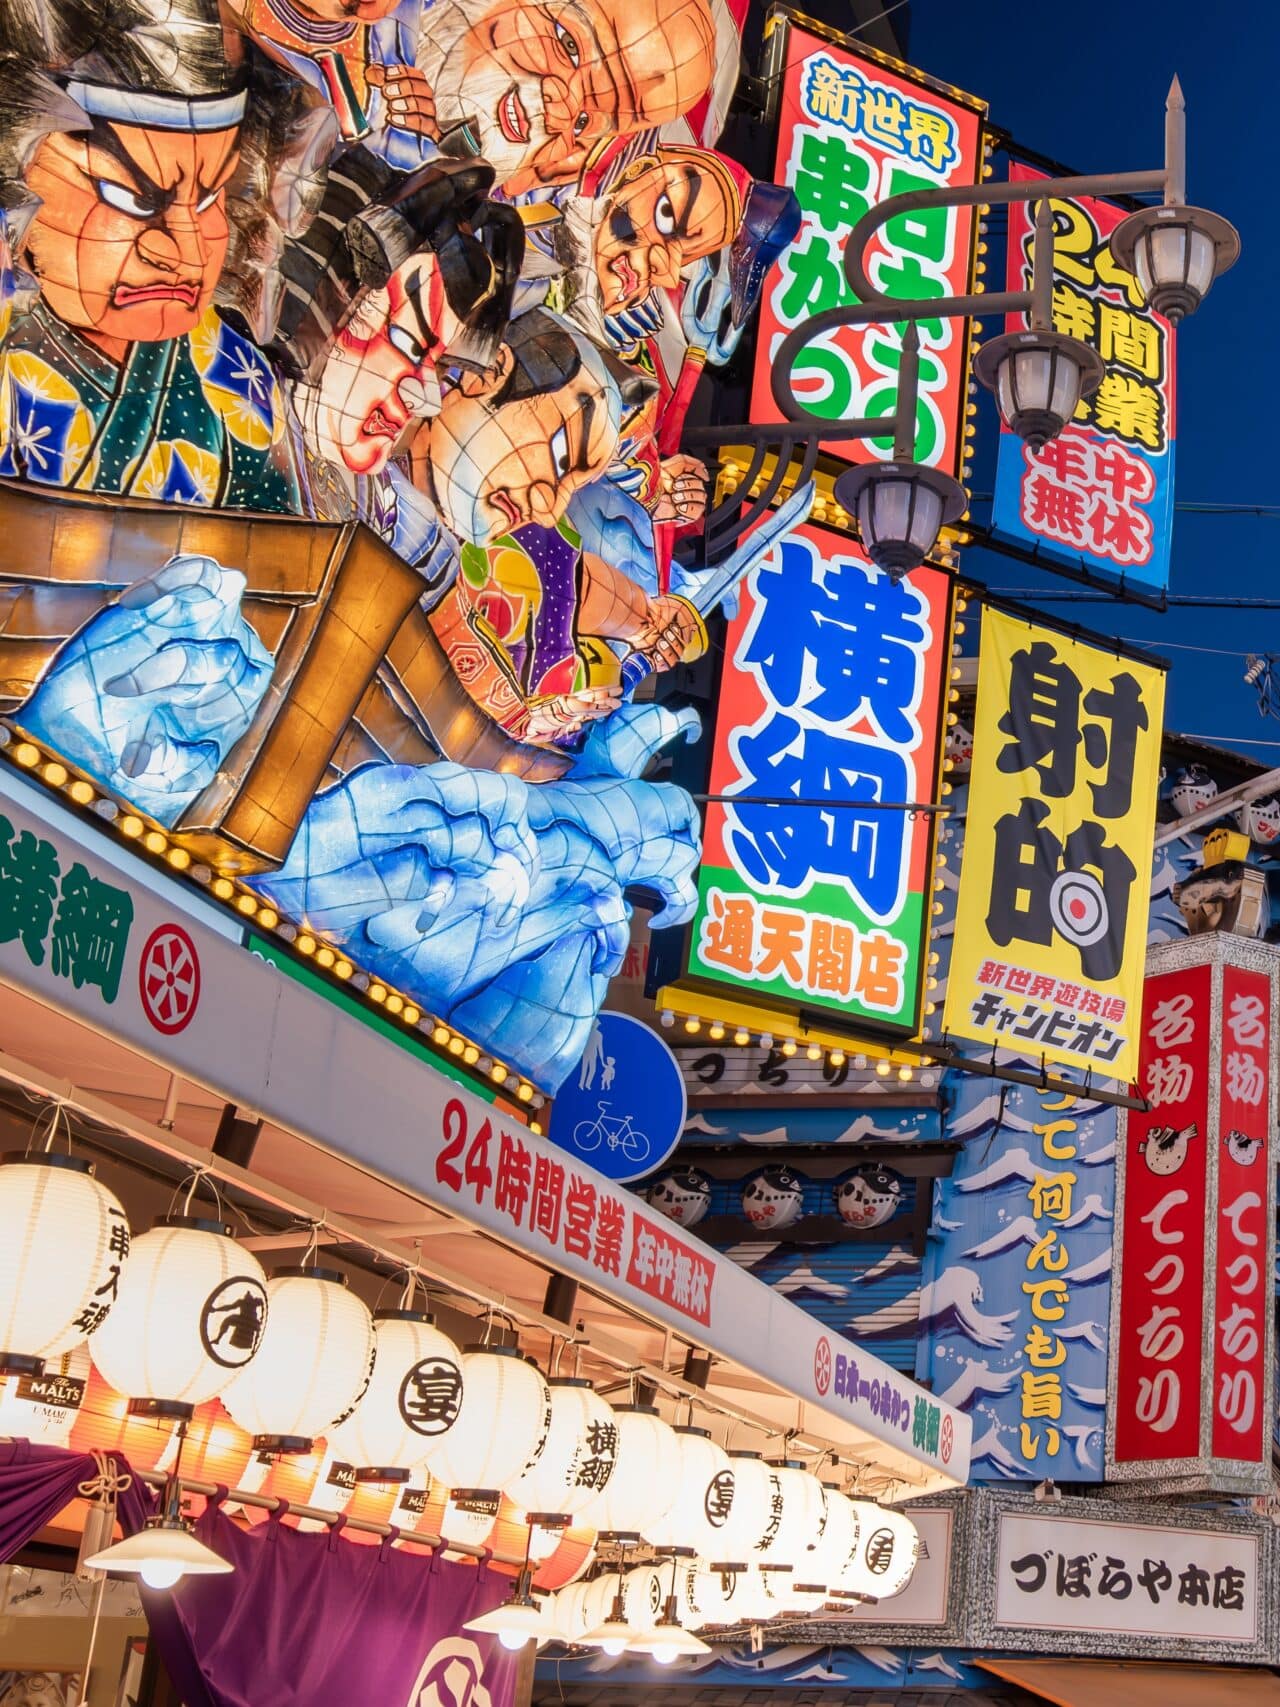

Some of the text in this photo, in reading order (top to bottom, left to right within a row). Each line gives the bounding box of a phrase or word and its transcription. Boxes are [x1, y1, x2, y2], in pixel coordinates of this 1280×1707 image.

[811, 60, 953, 165] 新世界
[780, 135, 872, 420] 串かつ
[1020, 436, 1150, 505] 年中
[1024, 472, 1150, 563] 無休
[727, 542, 925, 917] 横綱
[983, 641, 1150, 981] 射的
[704, 893, 903, 1007] 通天閣店
[976, 960, 1128, 1024] 新世界遊技場
[971, 991, 1125, 1063] チャンピオン
[1226, 992, 1265, 1107] 名物
[436, 1097, 710, 1319] 24時間営業 年中無休
[577, 1419, 618, 1493] 横綱
[833, 1353, 941, 1458] 日本一の串かつ 横綱
[752, 1474, 785, 1552] 千客万来
[1009, 1549, 1247, 1611] づぼらや本店
